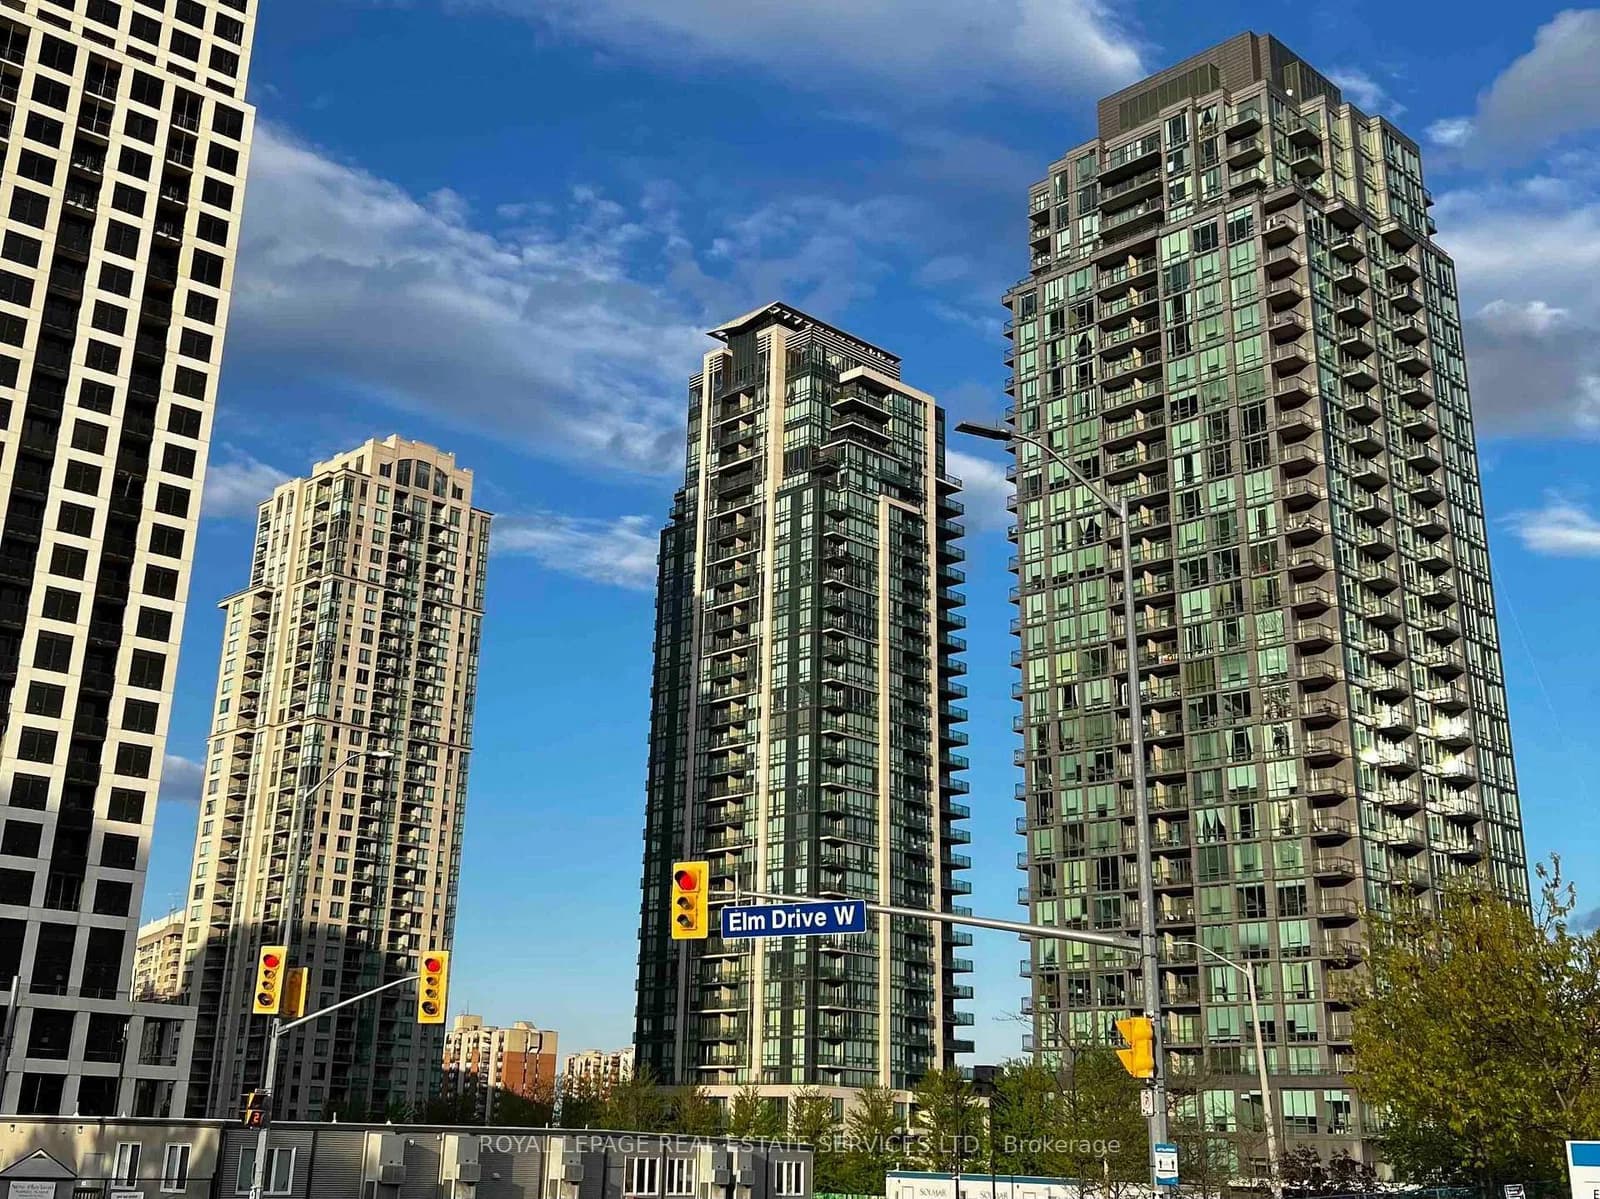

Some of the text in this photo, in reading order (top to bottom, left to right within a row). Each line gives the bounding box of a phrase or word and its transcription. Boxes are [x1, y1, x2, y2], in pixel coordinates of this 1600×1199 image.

[729, 905, 855, 932] Elm Drive W
